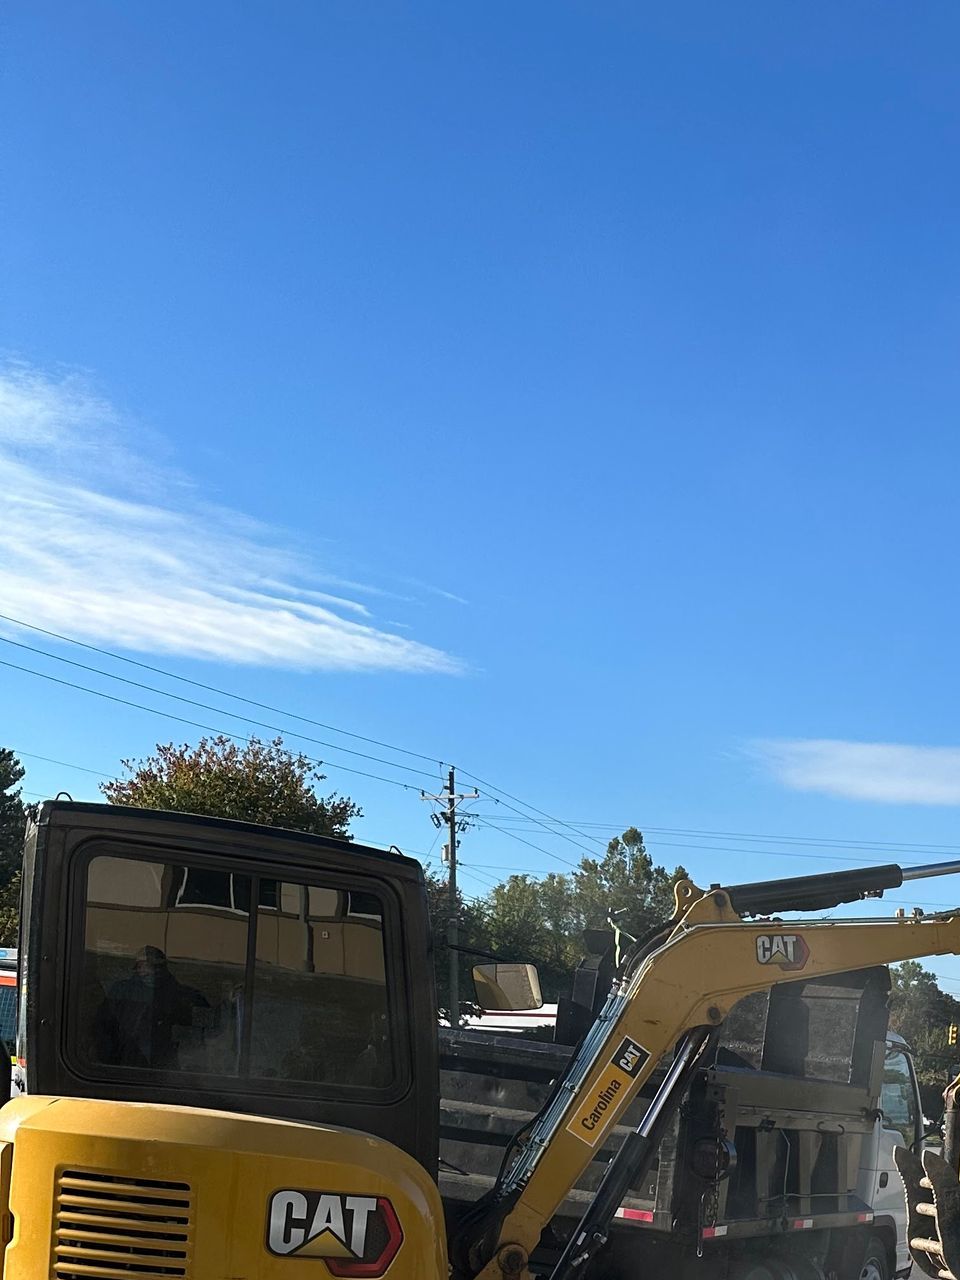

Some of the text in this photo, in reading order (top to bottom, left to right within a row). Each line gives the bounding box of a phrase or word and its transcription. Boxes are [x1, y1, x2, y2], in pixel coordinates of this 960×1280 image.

[756, 935, 797, 963] CAT
[581, 1045, 641, 1131] Carolina CAT
[269, 1190, 377, 1258] CAT
